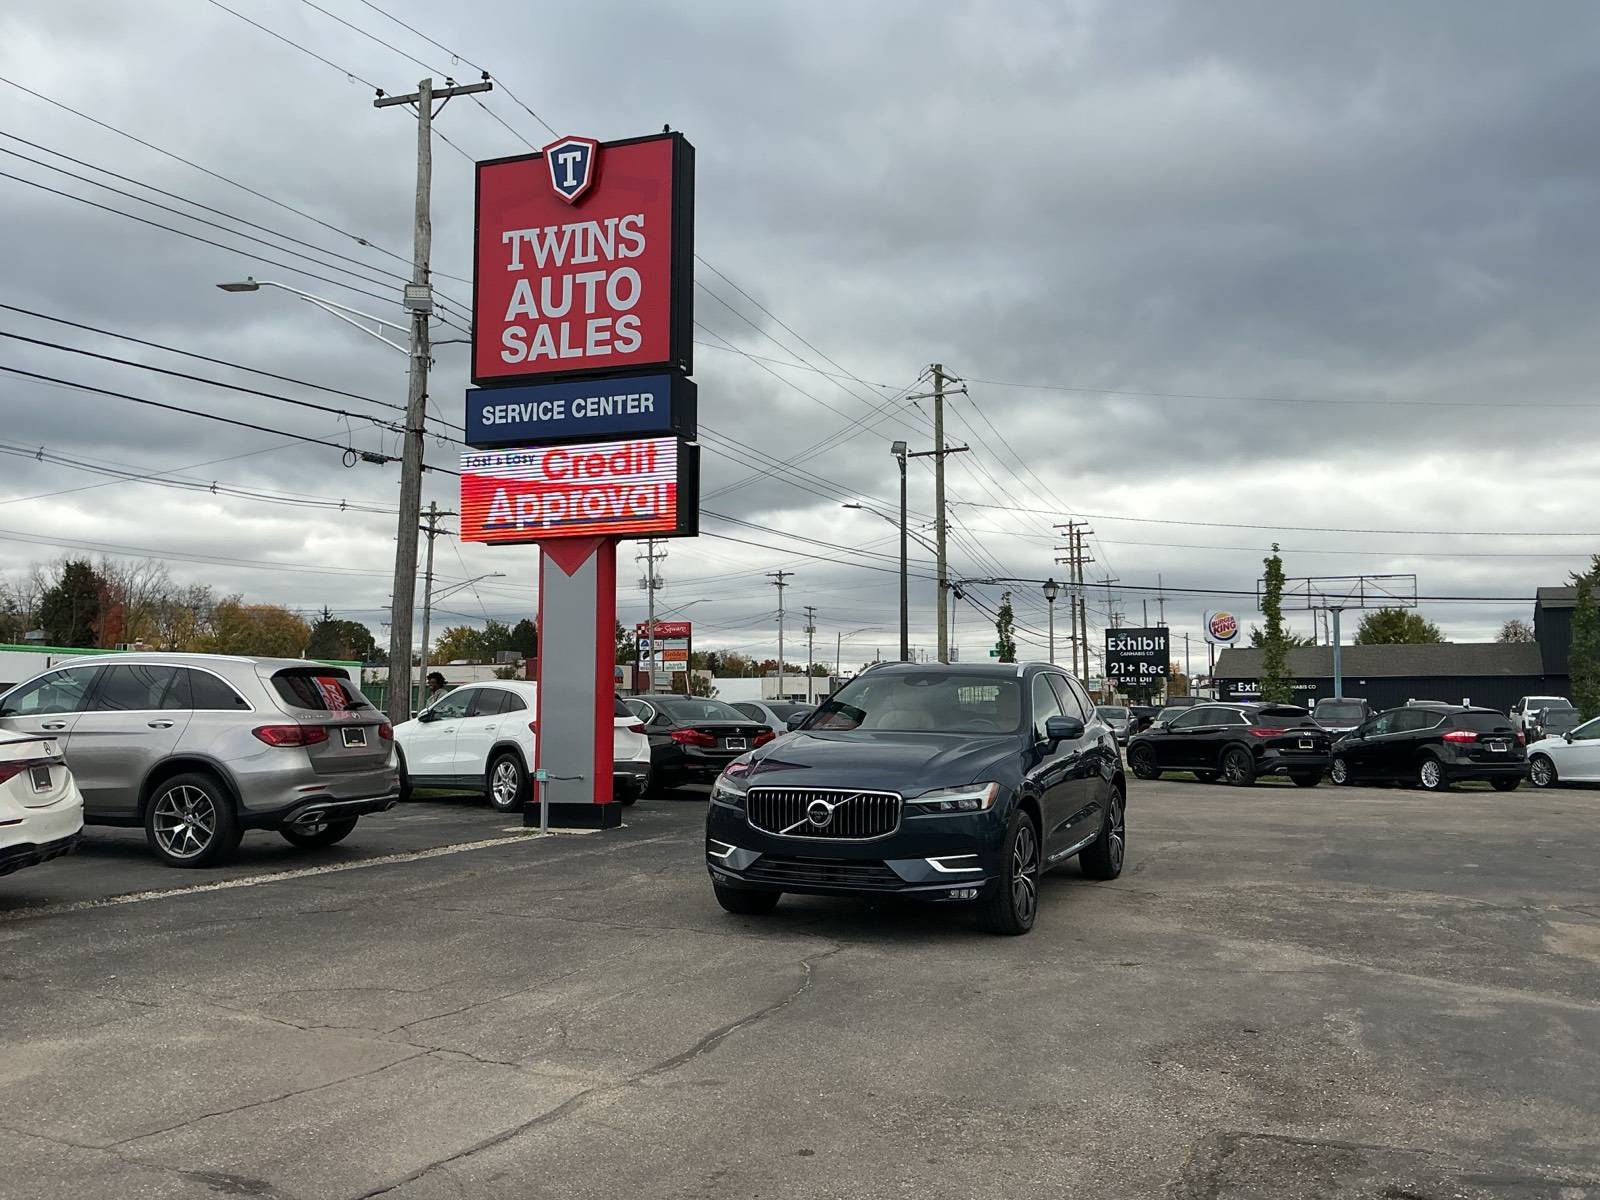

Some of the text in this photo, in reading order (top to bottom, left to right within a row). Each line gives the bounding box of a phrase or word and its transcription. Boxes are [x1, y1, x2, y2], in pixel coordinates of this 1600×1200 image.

[558, 151, 581, 187] T
[502, 213, 646, 271] TWINS
[504, 266, 642, 322] AUTO
[500, 314, 642, 364] SALES
[482, 393, 655, 425] SERVICE CENTER
[466, 456, 492, 467] Fast
[506, 453, 536, 465] Easy
[541, 441, 658, 480] Credit
[485, 483, 667, 530] Approval
[1211, 615, 1236, 628] BURGER
[1213, 621, 1237, 635] KING
[1108, 636, 1165, 650] Exhibit
[1110, 662, 1164, 674] 21+ Rec
